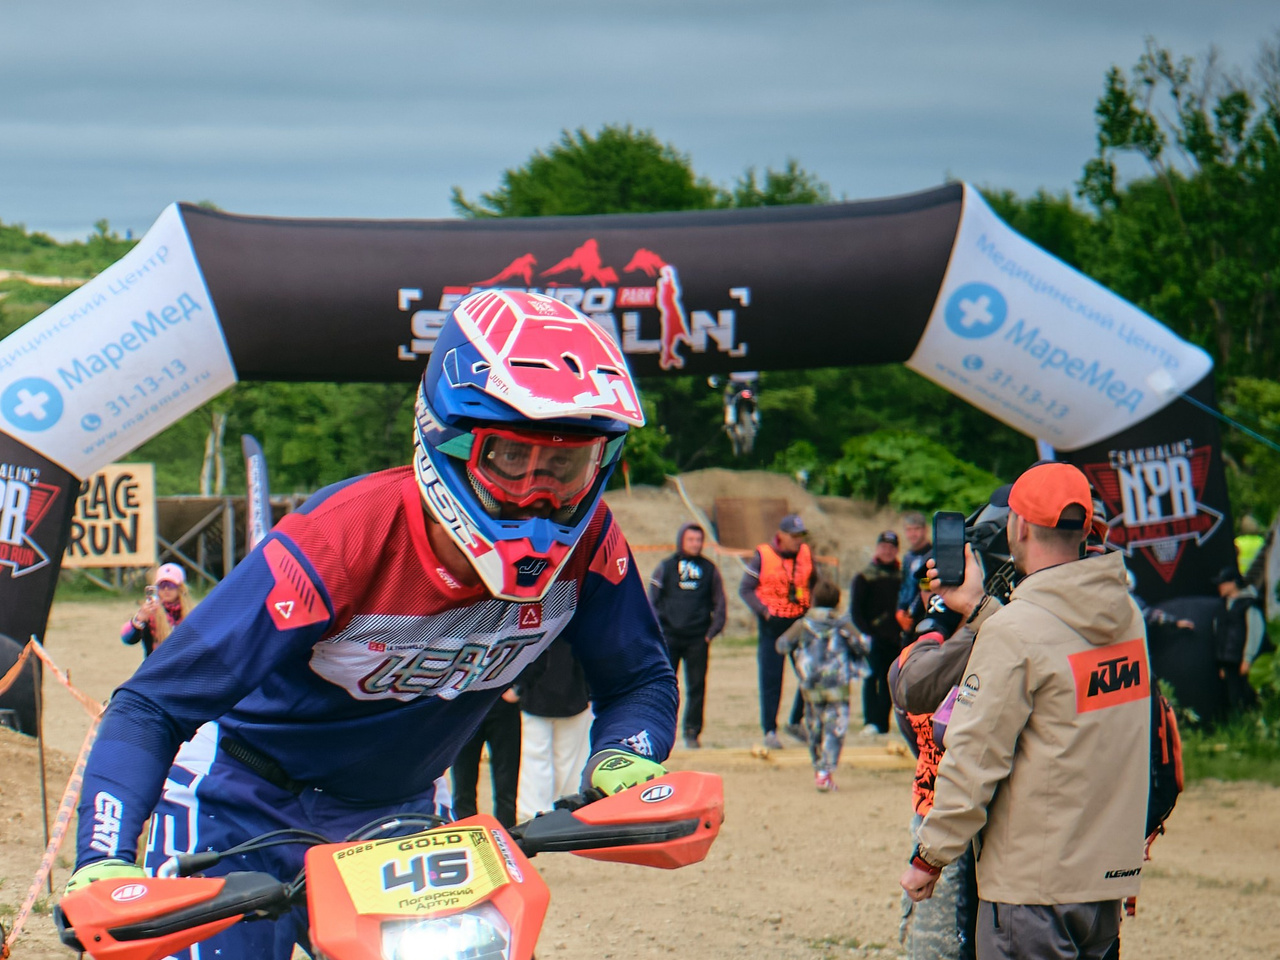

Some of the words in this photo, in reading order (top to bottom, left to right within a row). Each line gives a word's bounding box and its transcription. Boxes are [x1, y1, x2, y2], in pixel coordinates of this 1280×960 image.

[56, 291, 203, 391] МареМед
[1003, 317, 1145, 414] МареМед
[105, 358, 188, 418] 31-13-13
[1118, 456, 1198, 527] NPR
[67, 513, 139, 558] RUN
[1086, 656, 1141, 698] KTM
[89, 791, 123, 854] LEATT
[398, 833, 463, 852] GOLD
[384, 850, 470, 893] 46
[1104, 866, 1142, 879] KENNY
[398, 887, 474, 910] Погарский
[415, 897, 460, 912] Артур
